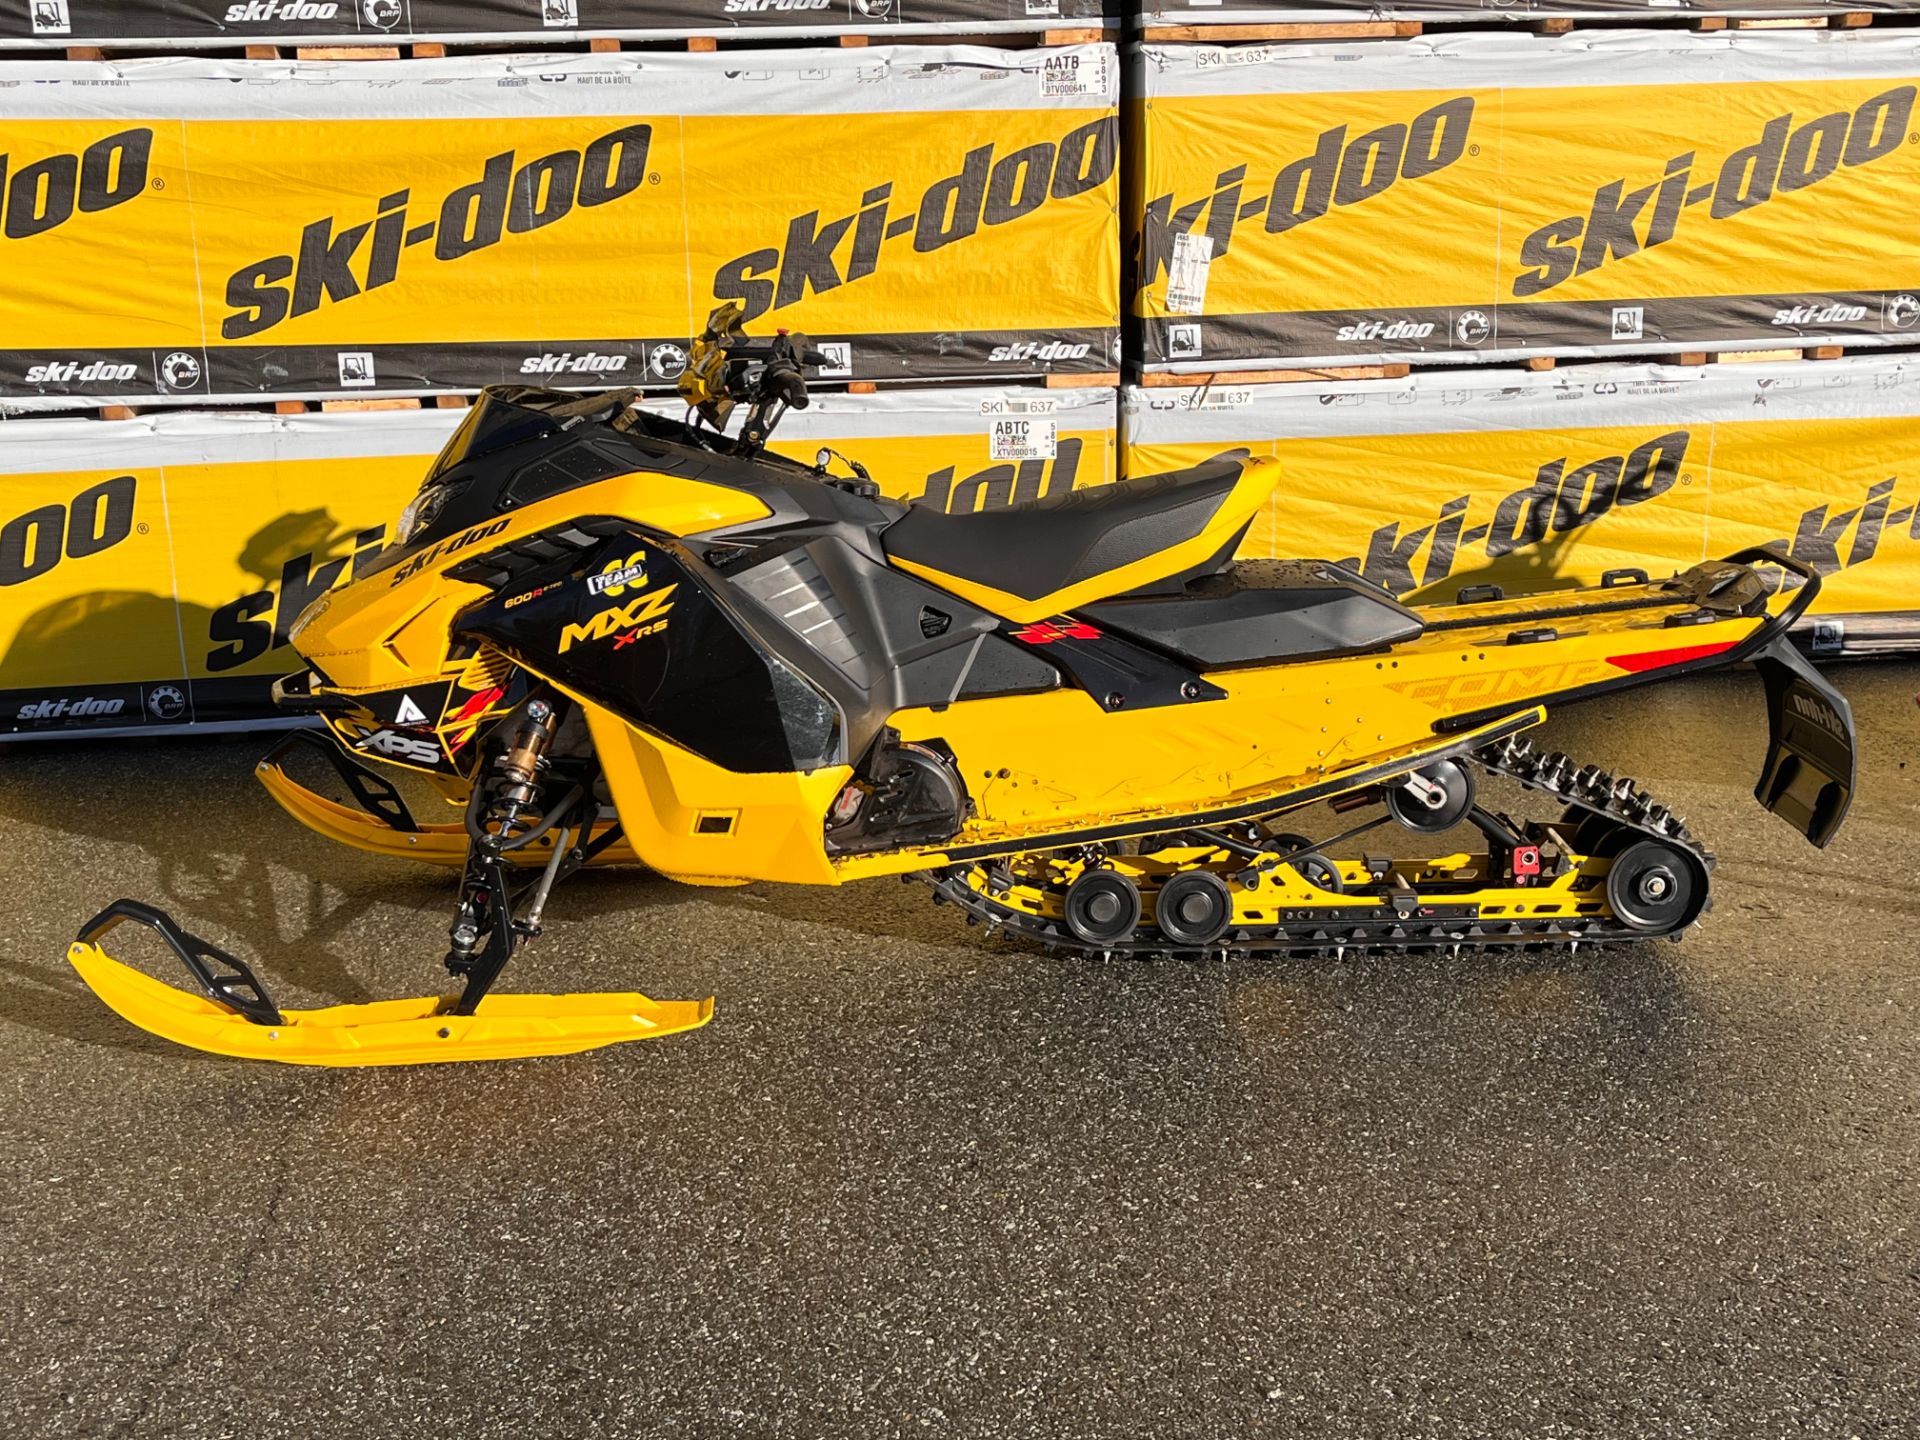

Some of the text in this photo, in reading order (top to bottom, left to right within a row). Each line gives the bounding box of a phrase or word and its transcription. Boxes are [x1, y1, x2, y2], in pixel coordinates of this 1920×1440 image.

[224, 0, 338, 21] ski-doo
[1045, 55, 1079, 70] AATB
[1198, 52, 1221, 66] SKI
[577, 76, 593, 84] HAUT
[594, 76, 603, 84] DE
[604, 76, 611, 84] LA
[0, 128, 153, 239] oo
[1512, 85, 1918, 297] ski-doo
[708, 115, 1119, 325] ski-doo
[221, 124, 652, 339] ski-doo
[1771, 304, 1868, 325] ski-doo
[1336, 320, 1435, 341] ski-doo
[988, 341, 1090, 361] ski-doo
[25, 361, 137, 382] ski-doo
[520, 352, 627, 374] ski-doo
[178, 371, 198, 379] BRP
[981, 401, 1003, 414] SKI
[1030, 401, 1053, 413] 637
[1228, 391, 1250, 404] 637
[995, 421, 1029, 435] ABTC
[390, 518, 514, 588] ski-doo
[595, 567, 638, 591] TEAM
[504, 588, 543, 609] 600R
[557, 582, 679, 654] MXZ
[16, 697, 125, 720] ski-doo
[164, 702, 183, 710] BRP
[356, 727, 440, 765] XPS
